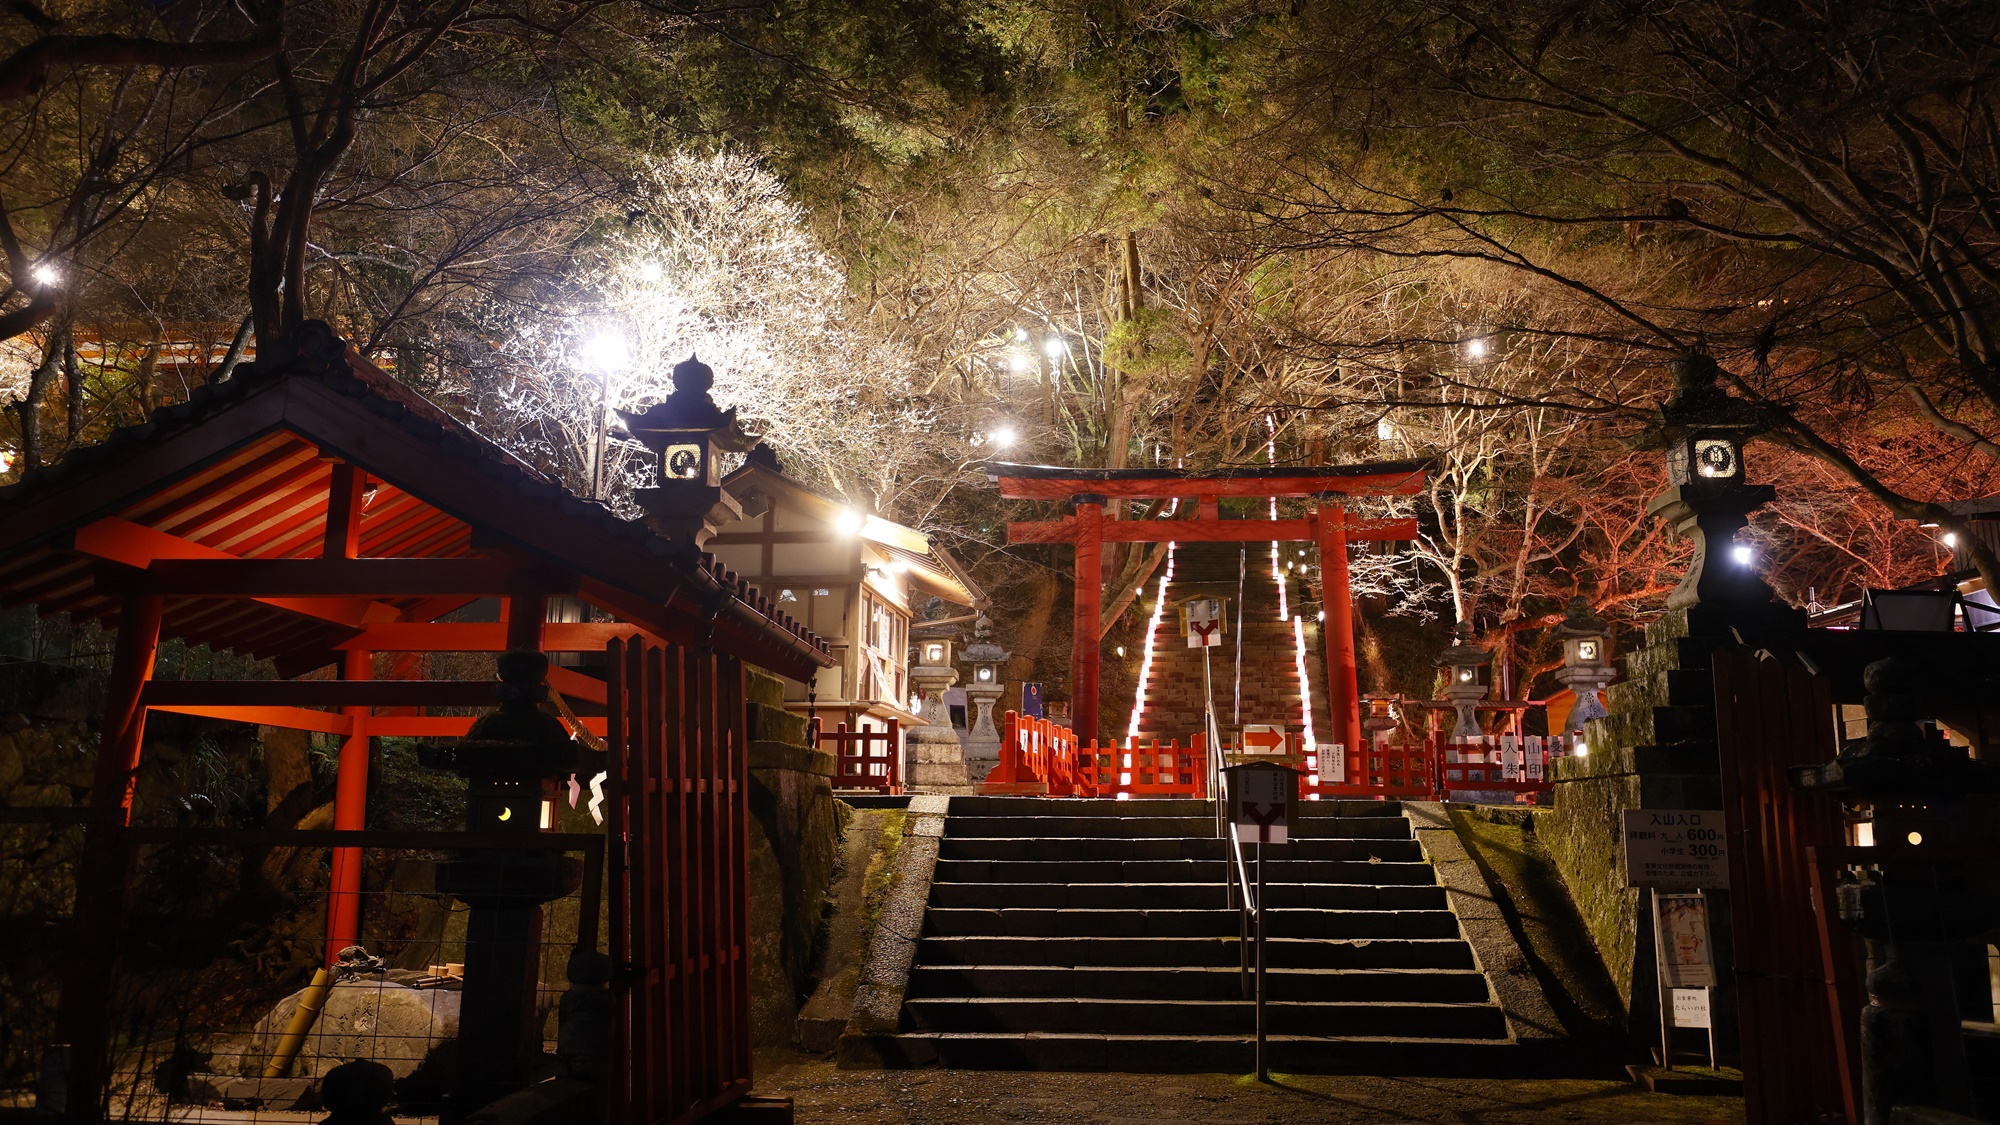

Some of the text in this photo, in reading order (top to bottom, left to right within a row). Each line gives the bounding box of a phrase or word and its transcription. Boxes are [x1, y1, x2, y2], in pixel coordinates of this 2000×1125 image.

[1650, 813, 1701, 826] 入山入口
[1629, 831, 1656, 840] 拝観料
[1661, 847, 1684, 856] 小学生
